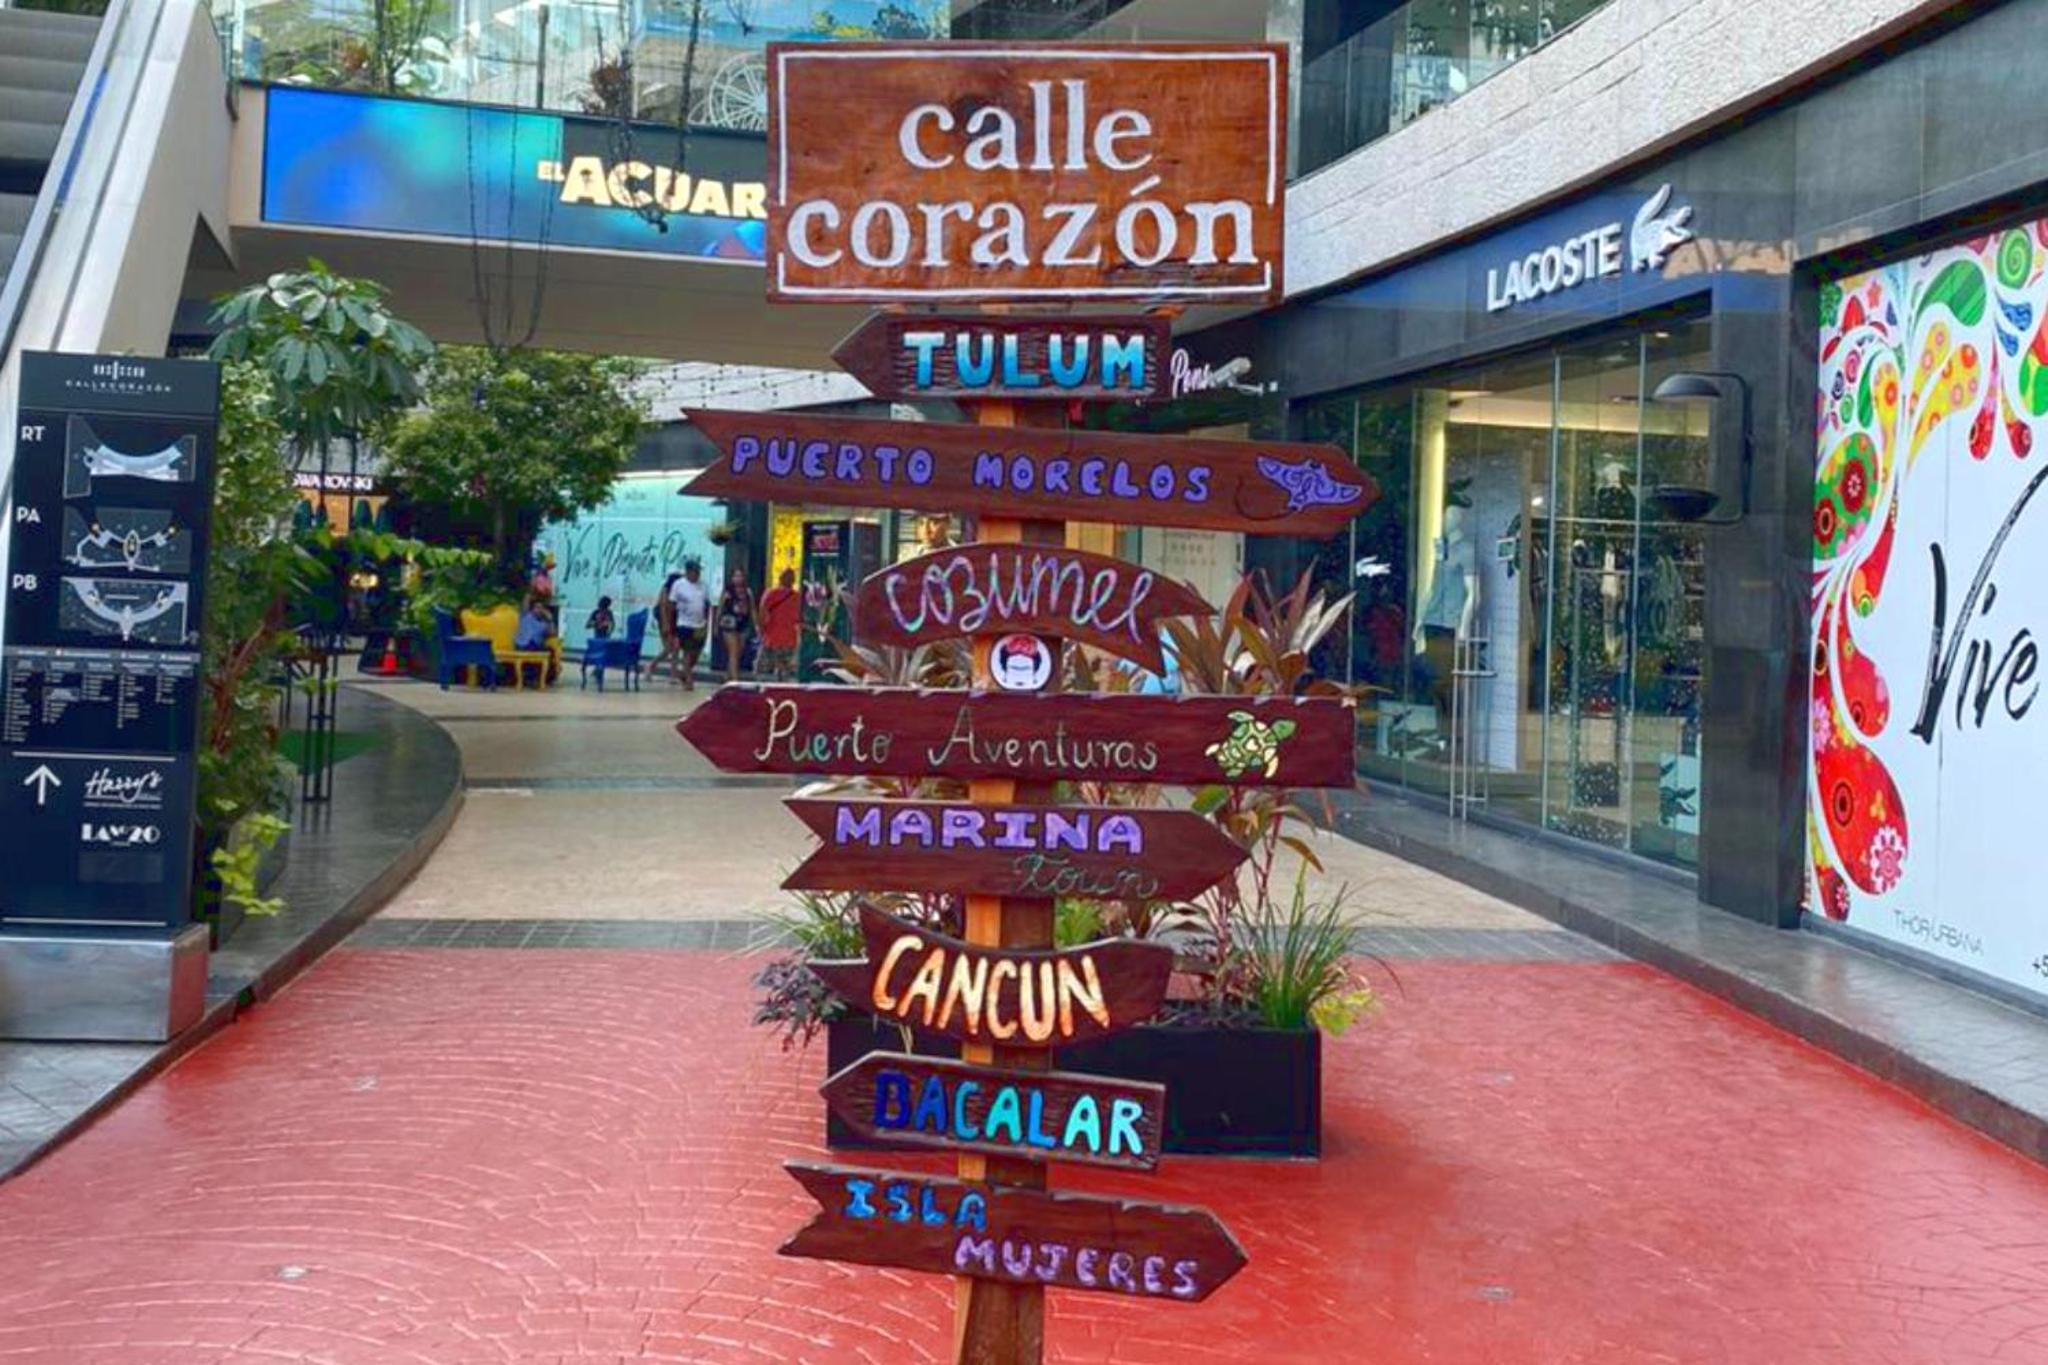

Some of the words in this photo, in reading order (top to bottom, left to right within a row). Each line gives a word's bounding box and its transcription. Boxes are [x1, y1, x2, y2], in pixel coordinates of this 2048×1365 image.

[900, 79, 1153, 172] calle
[537, 161, 564, 181] EL
[786, 175, 1259, 268] corazón
[1486, 222, 1623, 312] LACOSTE
[903, 331, 1147, 389] TULUM
[21, 426, 46, 441] RT
[732, 435, 934, 485] PUERTO
[973, 452, 1212, 501] MORELOS
[16, 507, 41, 523] PA
[12, 574, 38, 590] PB
[1910, 462, 2048, 746] Vive
[753, 698, 893, 764] Puerto
[927, 704, 1159, 771] Aventuras
[84, 767, 163, 803] Harry's
[835, 804, 1145, 853] MARINA
[1012, 852, 1158, 899] Town
[872, 935, 1111, 1042] CANCUN
[874, 1070, 1144, 1156] BACALAR
[844, 1179, 988, 1231] ISLA
[954, 1235, 1199, 1297] MUJERES
